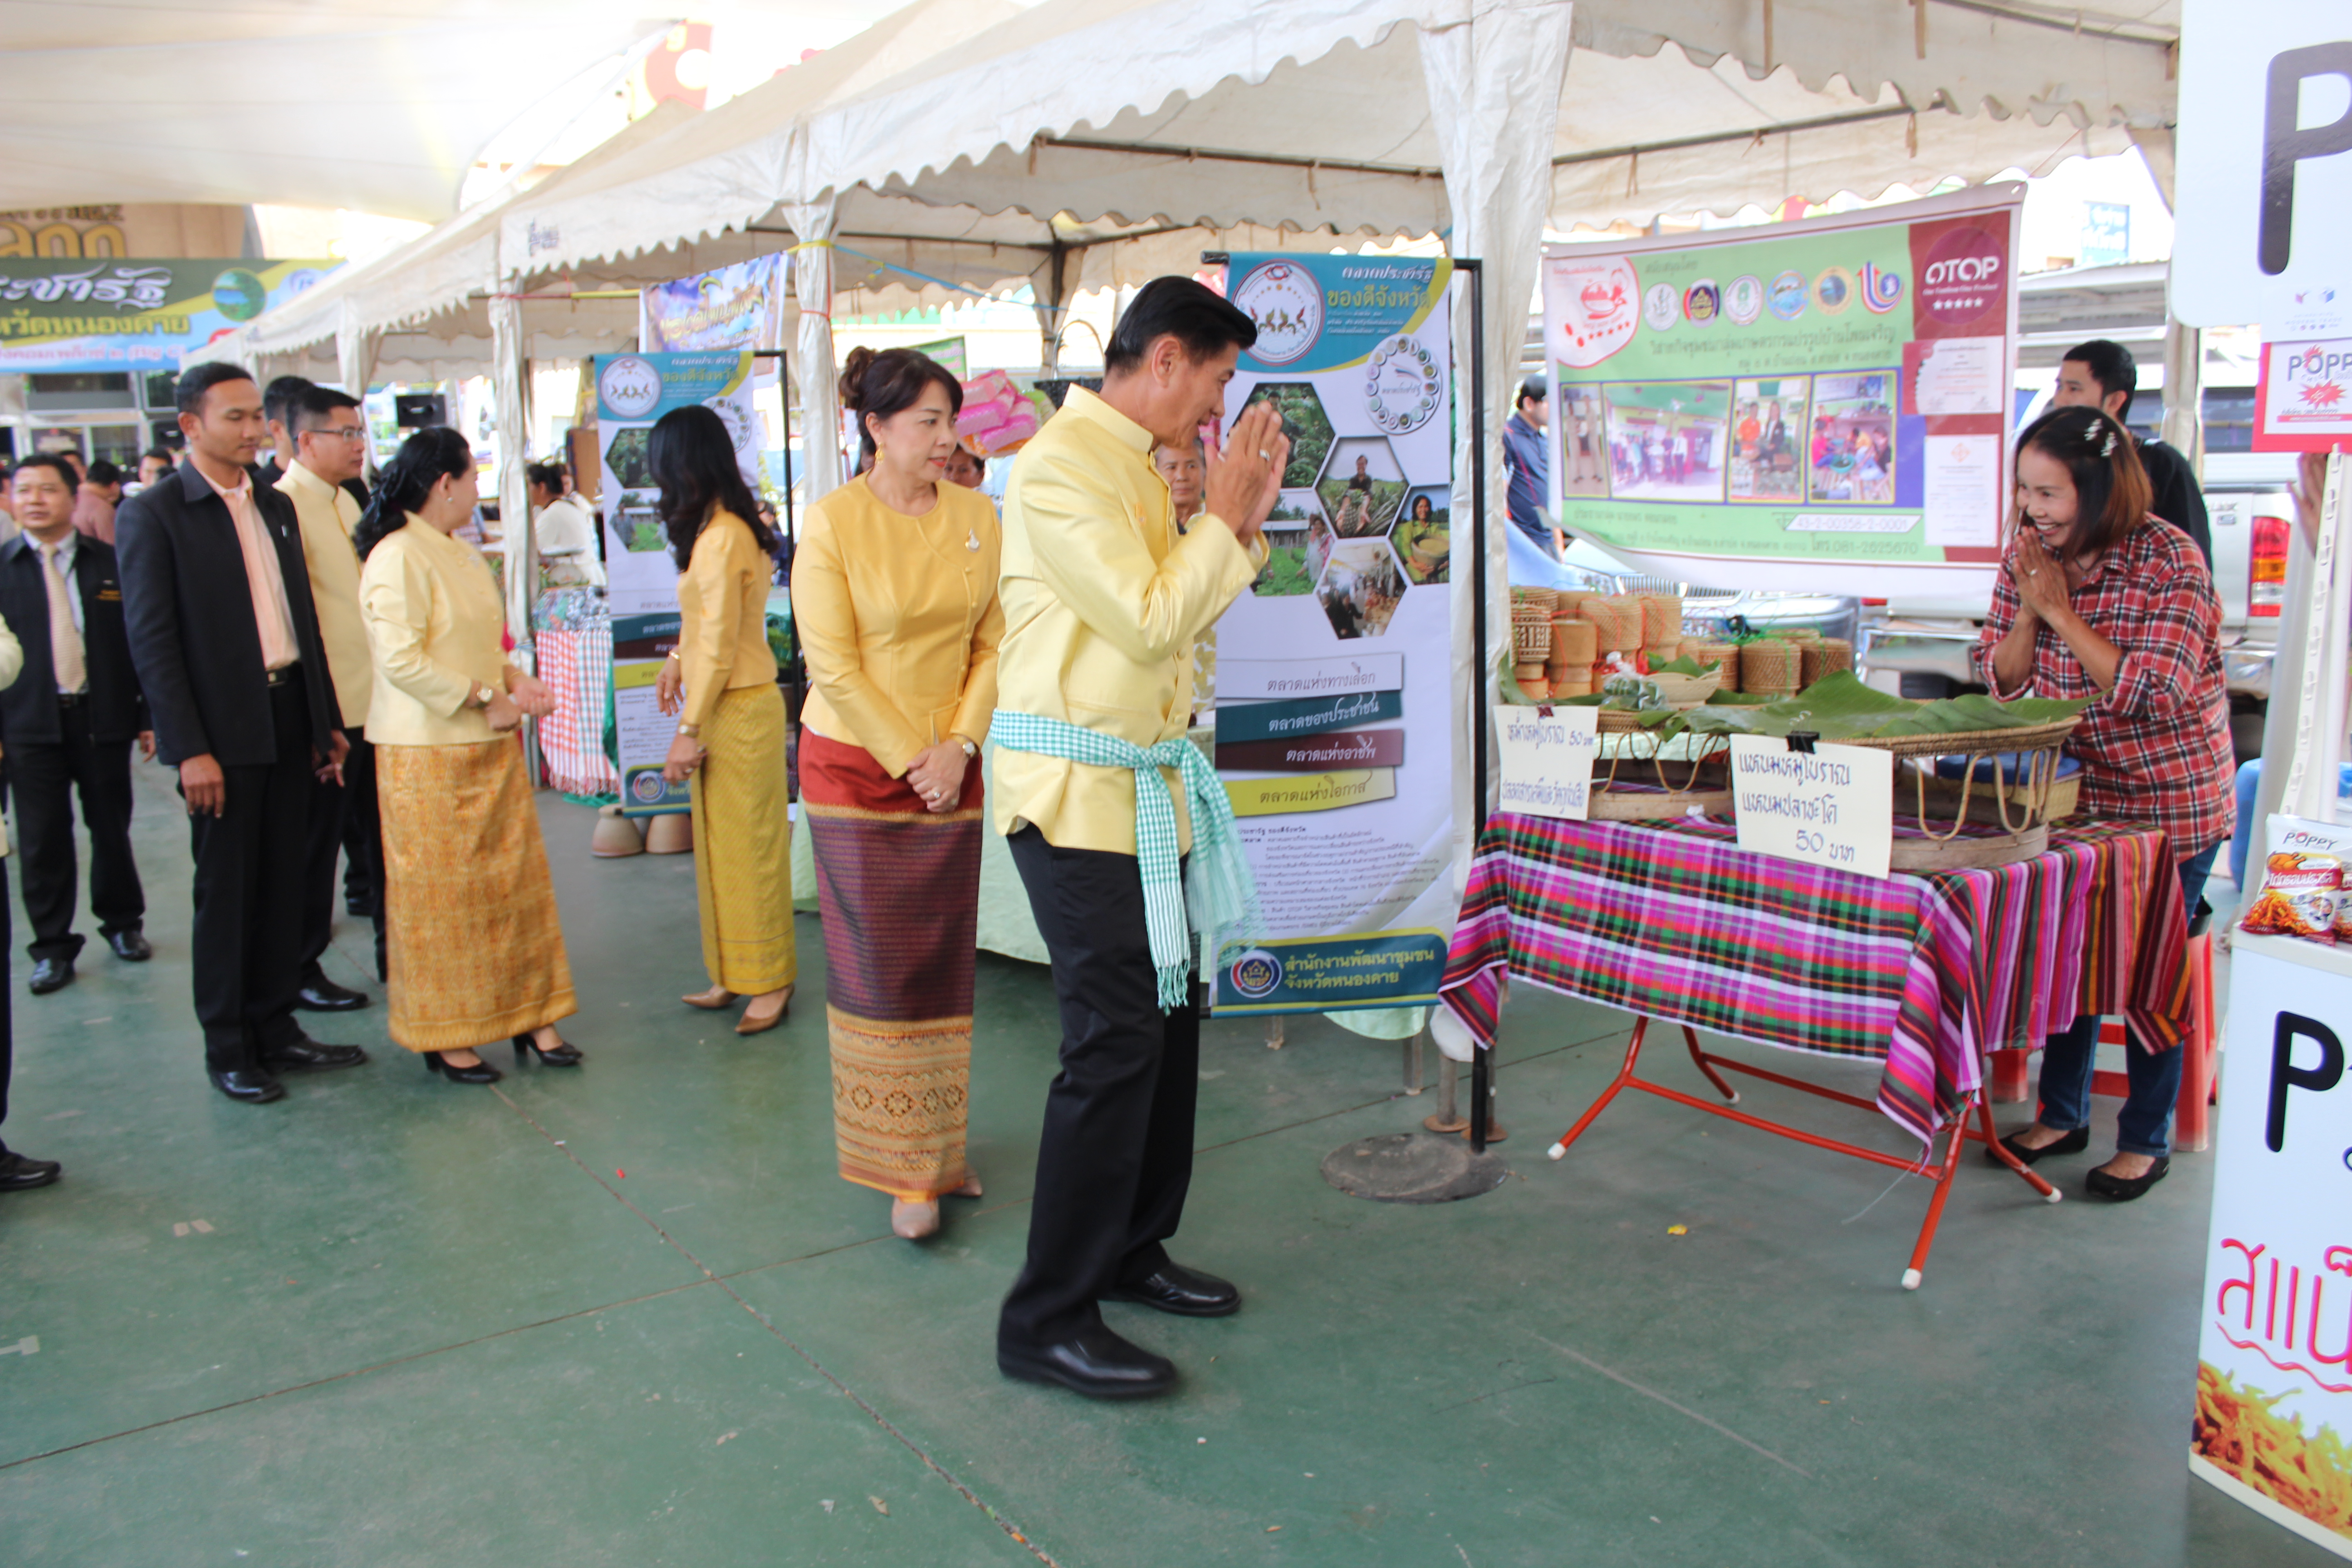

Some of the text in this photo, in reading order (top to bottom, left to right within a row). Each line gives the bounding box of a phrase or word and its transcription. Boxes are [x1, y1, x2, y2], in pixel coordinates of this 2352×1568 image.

[1342, 263, 1434, 284] ตลาดประชารัฐ
[1925, 255, 1999, 285] OTOP
[0, 262, 172, 310] ะชารัฐ
[1327, 284, 1431, 309] ของดีจังหวัด
[1267, 662, 1376, 691] ตลาดแห่งทางเลือก
[1269, 691, 1380, 731] ตลาดของประชาชน
[1286, 735, 1377, 761] ตลาดแห่งอาชีพ
[1569, 730, 1583, 745] 50
[1739, 752, 1850, 786] แหนมหมูโบราณ
[1260, 770, 1373, 803] ตลาดแห่งโอกาส
[1742, 793, 1838, 824] แหนมปลาชะโด
[1796, 829, 1855, 862] 50 บาท
[2283, 832, 2337, 851] POPPY
[1285, 949, 1435, 971] สำนักงานพัฒนาชุมชน
[1284, 971, 1399, 990] จังหวัดหนองคาย
